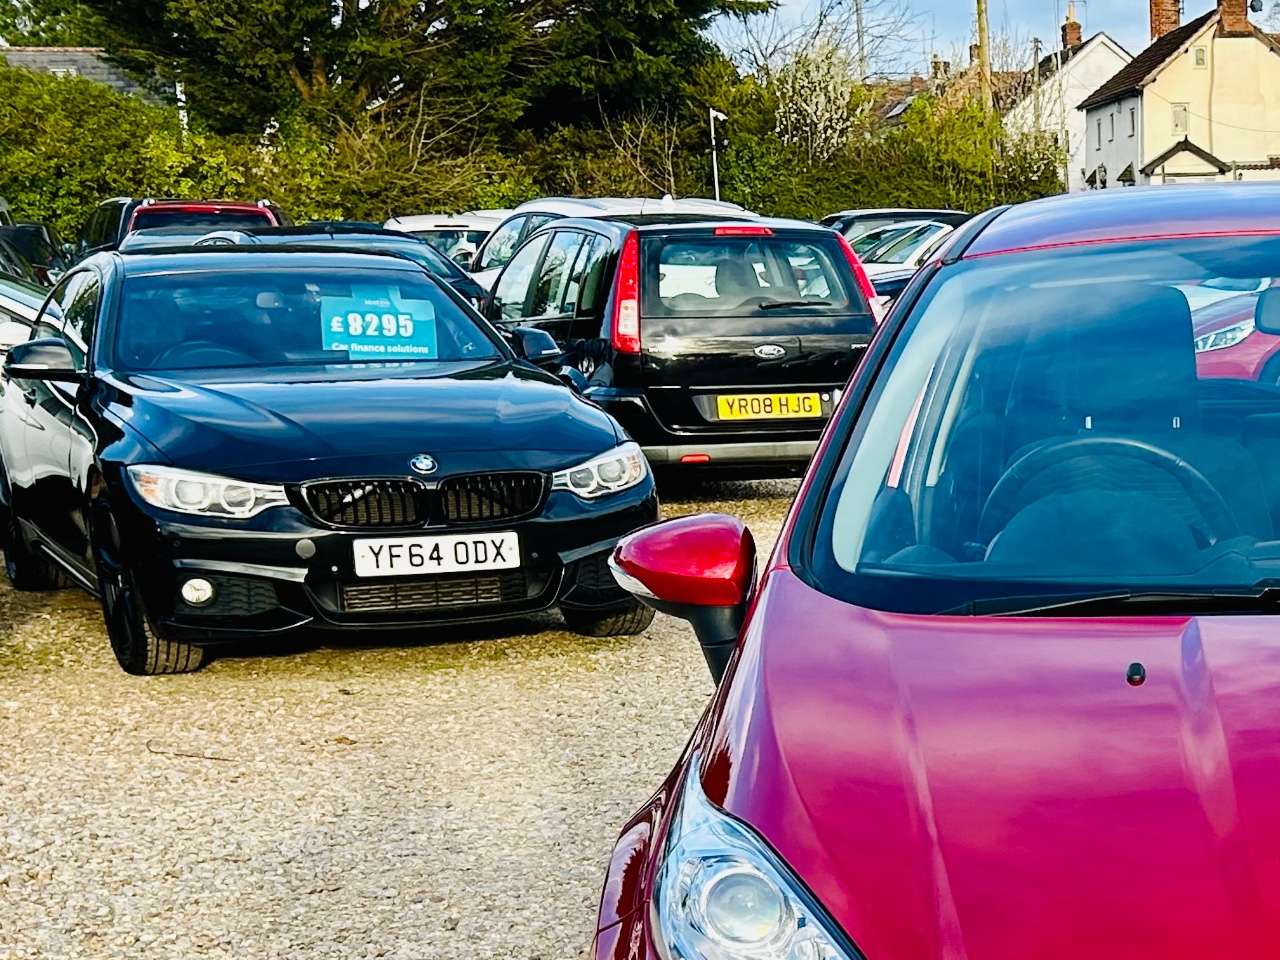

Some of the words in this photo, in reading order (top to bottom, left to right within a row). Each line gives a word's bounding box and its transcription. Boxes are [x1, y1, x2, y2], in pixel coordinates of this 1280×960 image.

[331, 342, 349, 351] Car
[351, 343, 385, 353] finance
[387, 344, 429, 354] solutions
[724, 399, 773, 415] YR08
[778, 396, 813, 413] HJG
[368, 542, 443, 569] YF64
[454, 538, 507, 565] ODX
